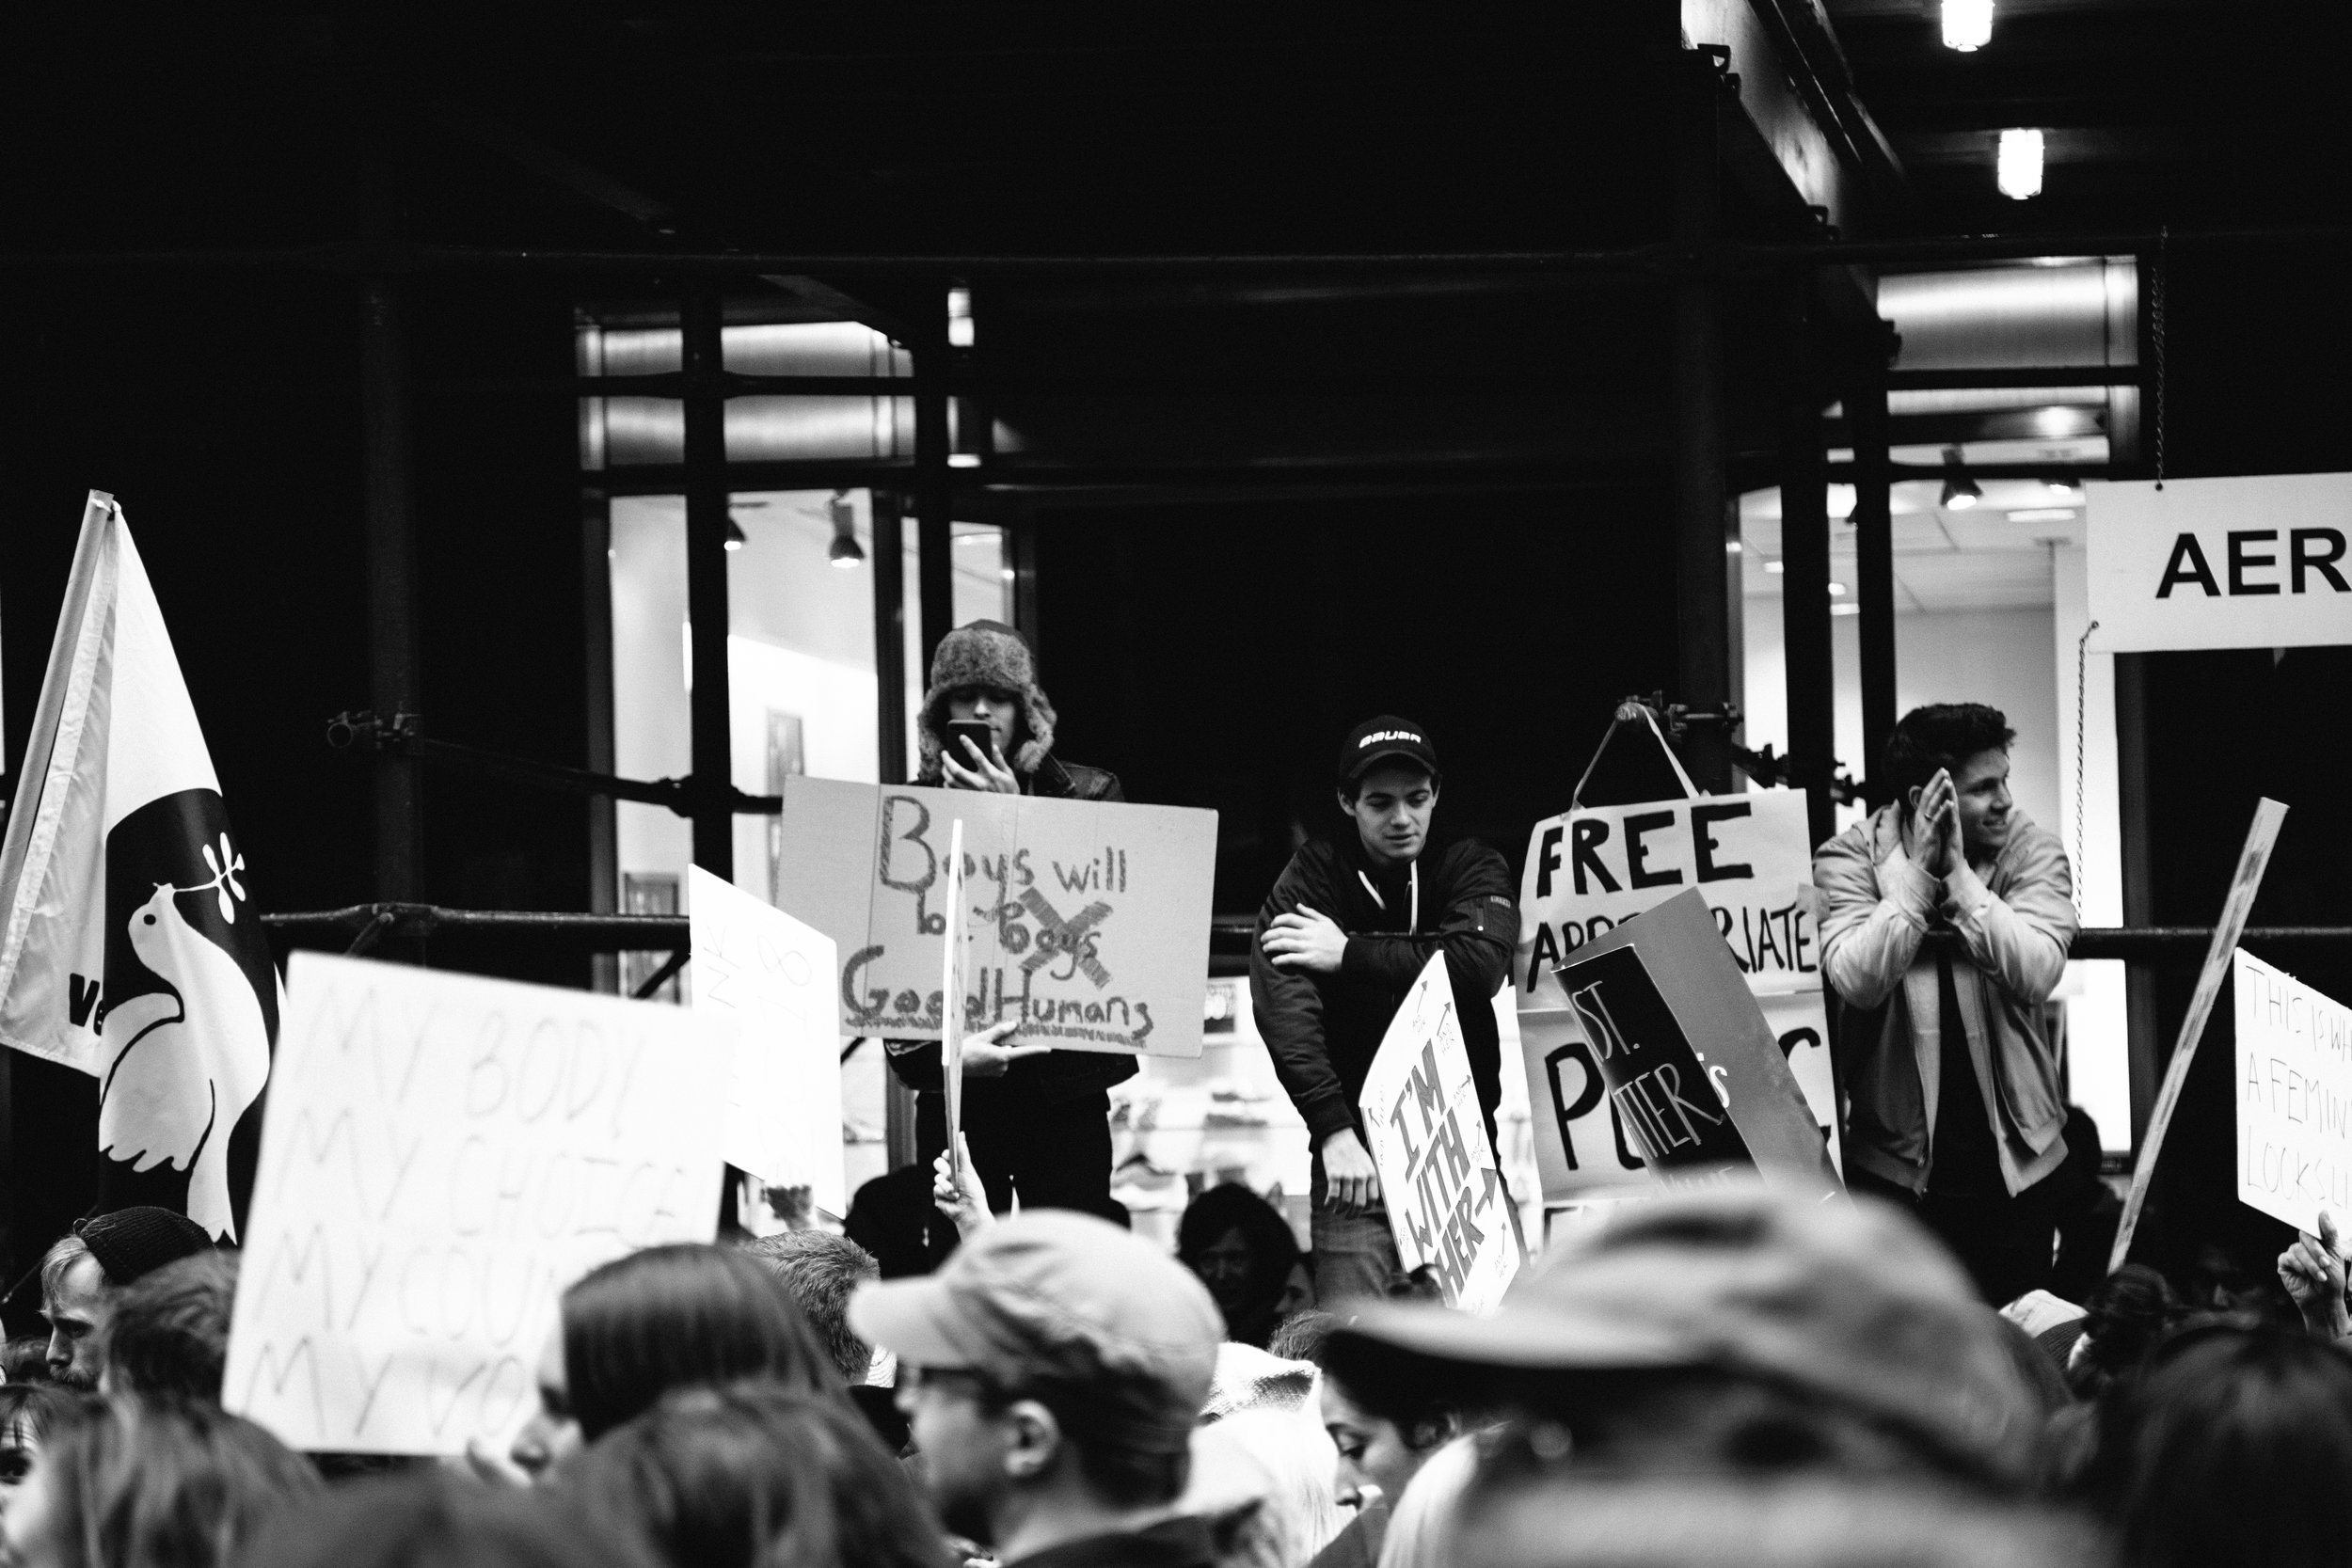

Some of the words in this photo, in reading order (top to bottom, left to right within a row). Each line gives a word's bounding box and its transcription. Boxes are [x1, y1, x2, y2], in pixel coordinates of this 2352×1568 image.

[2155, 528, 2352, 598] AER
[1054, 846, 1127, 894] will
[1536, 801, 1755, 899] FREE
[1526, 900, 1819, 993] APRIATE
[2246, 964, 2302, 1035] THIS
[2312, 1004, 2325, 1053] IS
[294, 983, 439, 1106] MY
[465, 1008, 648, 1141] BODY
[2248, 1051, 2262, 1103] A
[2269, 1058, 2352, 1140] FEMIN
[275, 1107, 423, 1222] MY
[1405, 1106, 1470, 1266] WITH
[2247, 1124, 2327, 1202] LOOKS
[252, 1222, 385, 1331] MY
[399, 1244, 557, 1348] COU
[1434, 1186, 1486, 1309] HER
[245, 1335, 395, 1439] MY
